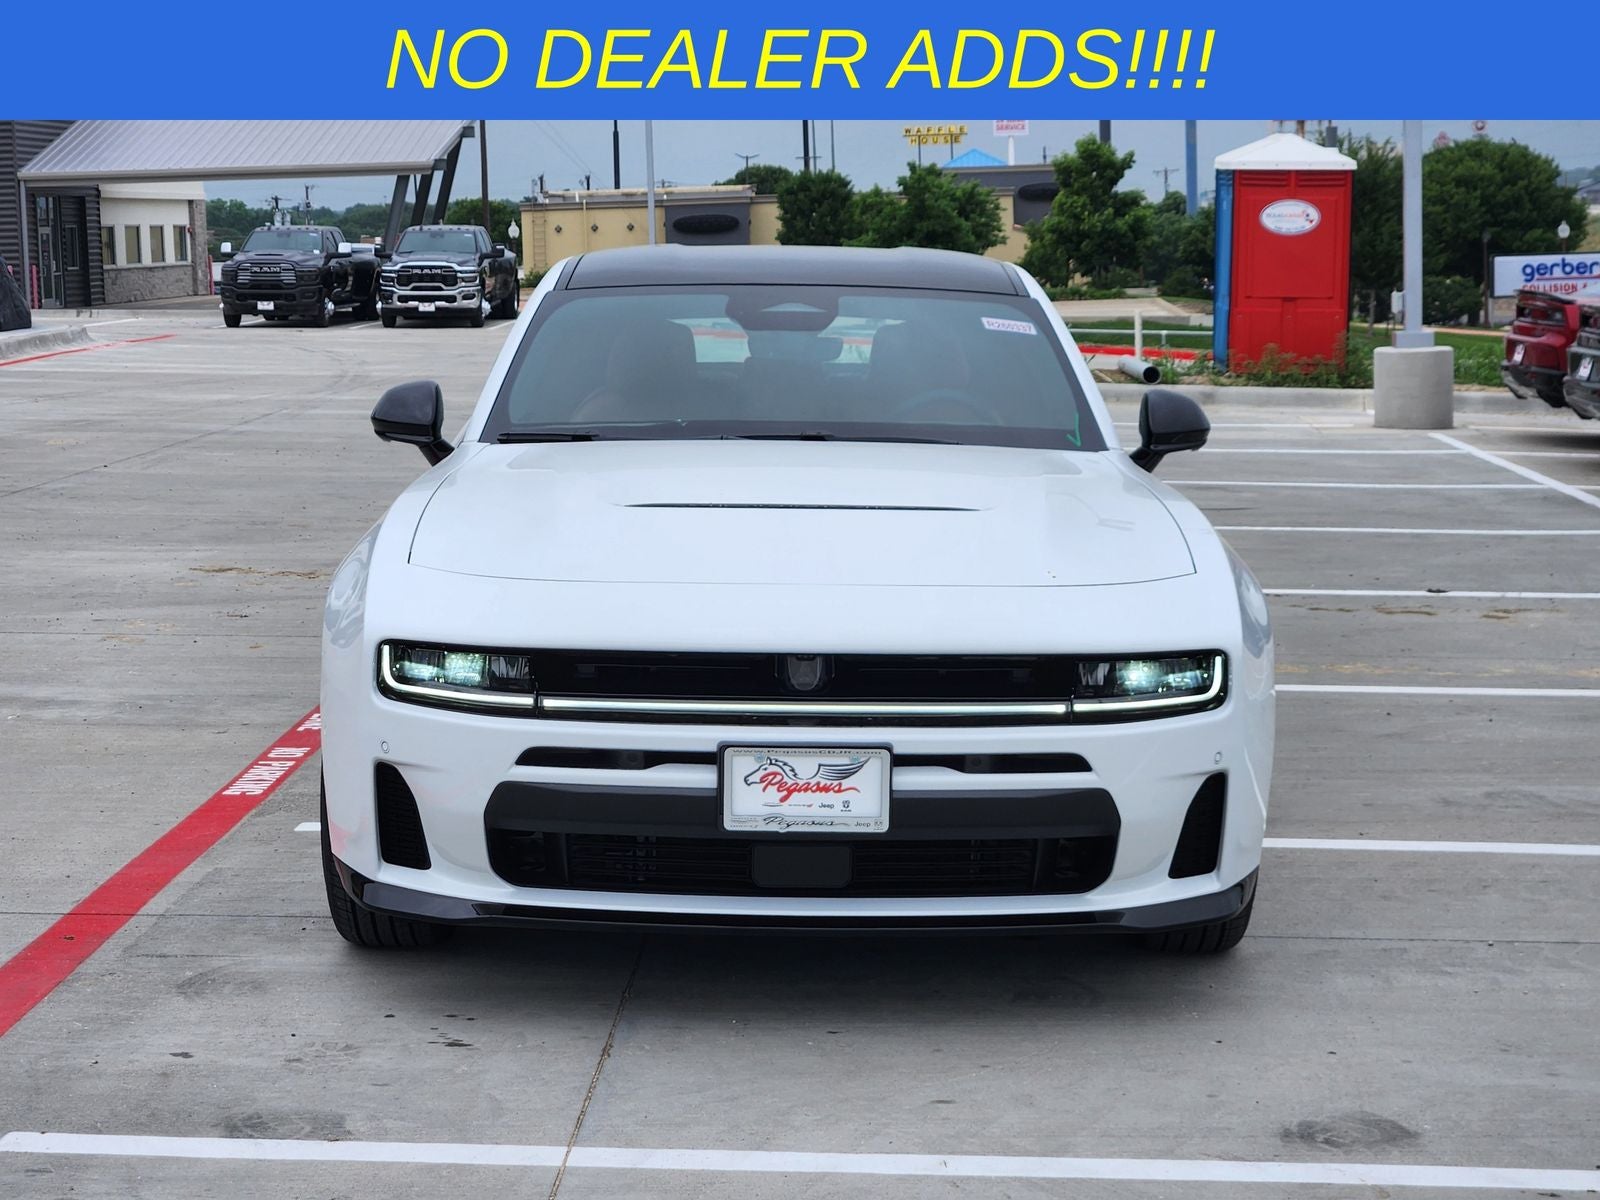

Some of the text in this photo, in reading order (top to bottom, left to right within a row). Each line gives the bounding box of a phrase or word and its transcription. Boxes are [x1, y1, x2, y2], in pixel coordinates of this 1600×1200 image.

[904, 125, 967, 135] WAFFLE
[910, 135, 962, 145] HOUSE
[1522, 257, 1600, 282] gerber
[1522, 283, 1578, 293] COLLISION
[222, 747, 311, 795] NO PARKING
[759, 771, 861, 803] Pegasus
[763, 816, 850, 829] Pegasus
